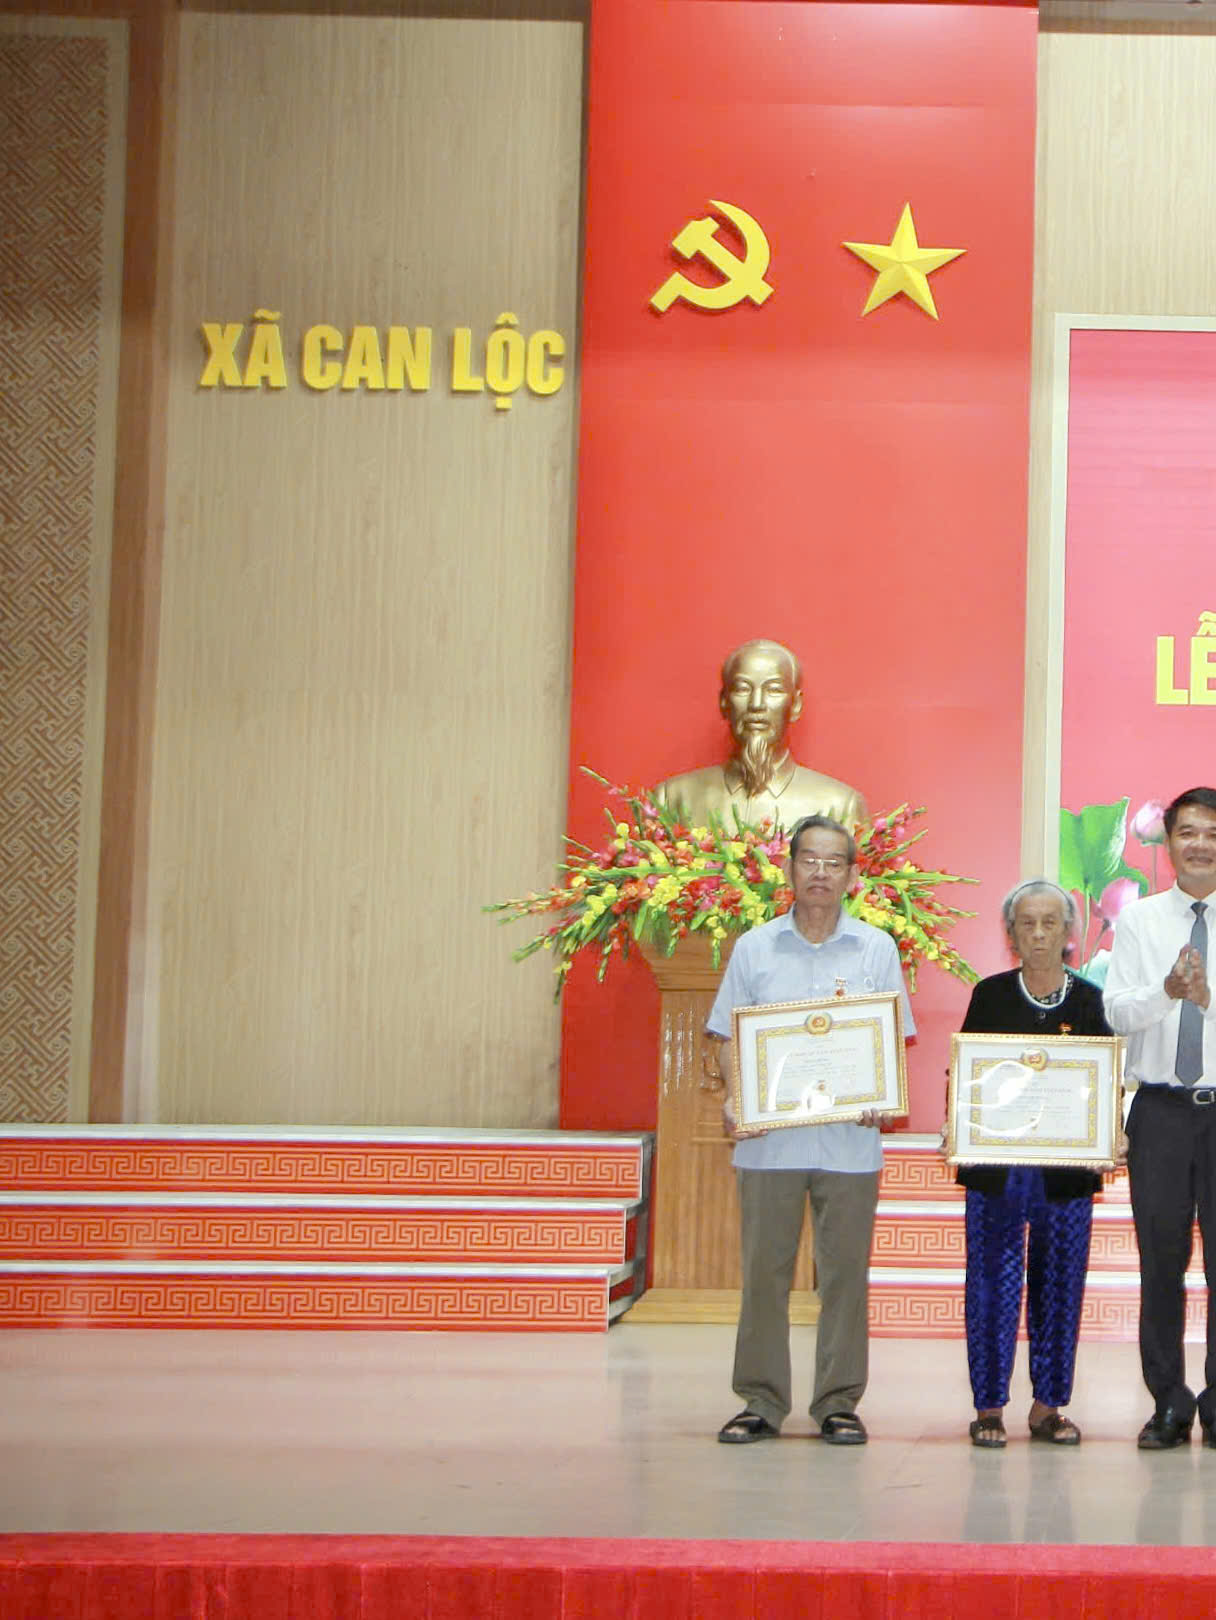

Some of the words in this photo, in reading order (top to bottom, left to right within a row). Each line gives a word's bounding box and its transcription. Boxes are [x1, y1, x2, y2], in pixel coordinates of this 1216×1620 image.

[199, 308, 288, 388] XÃ
[303, 323, 433, 391] CAN
[451, 311, 567, 412] LỘC
